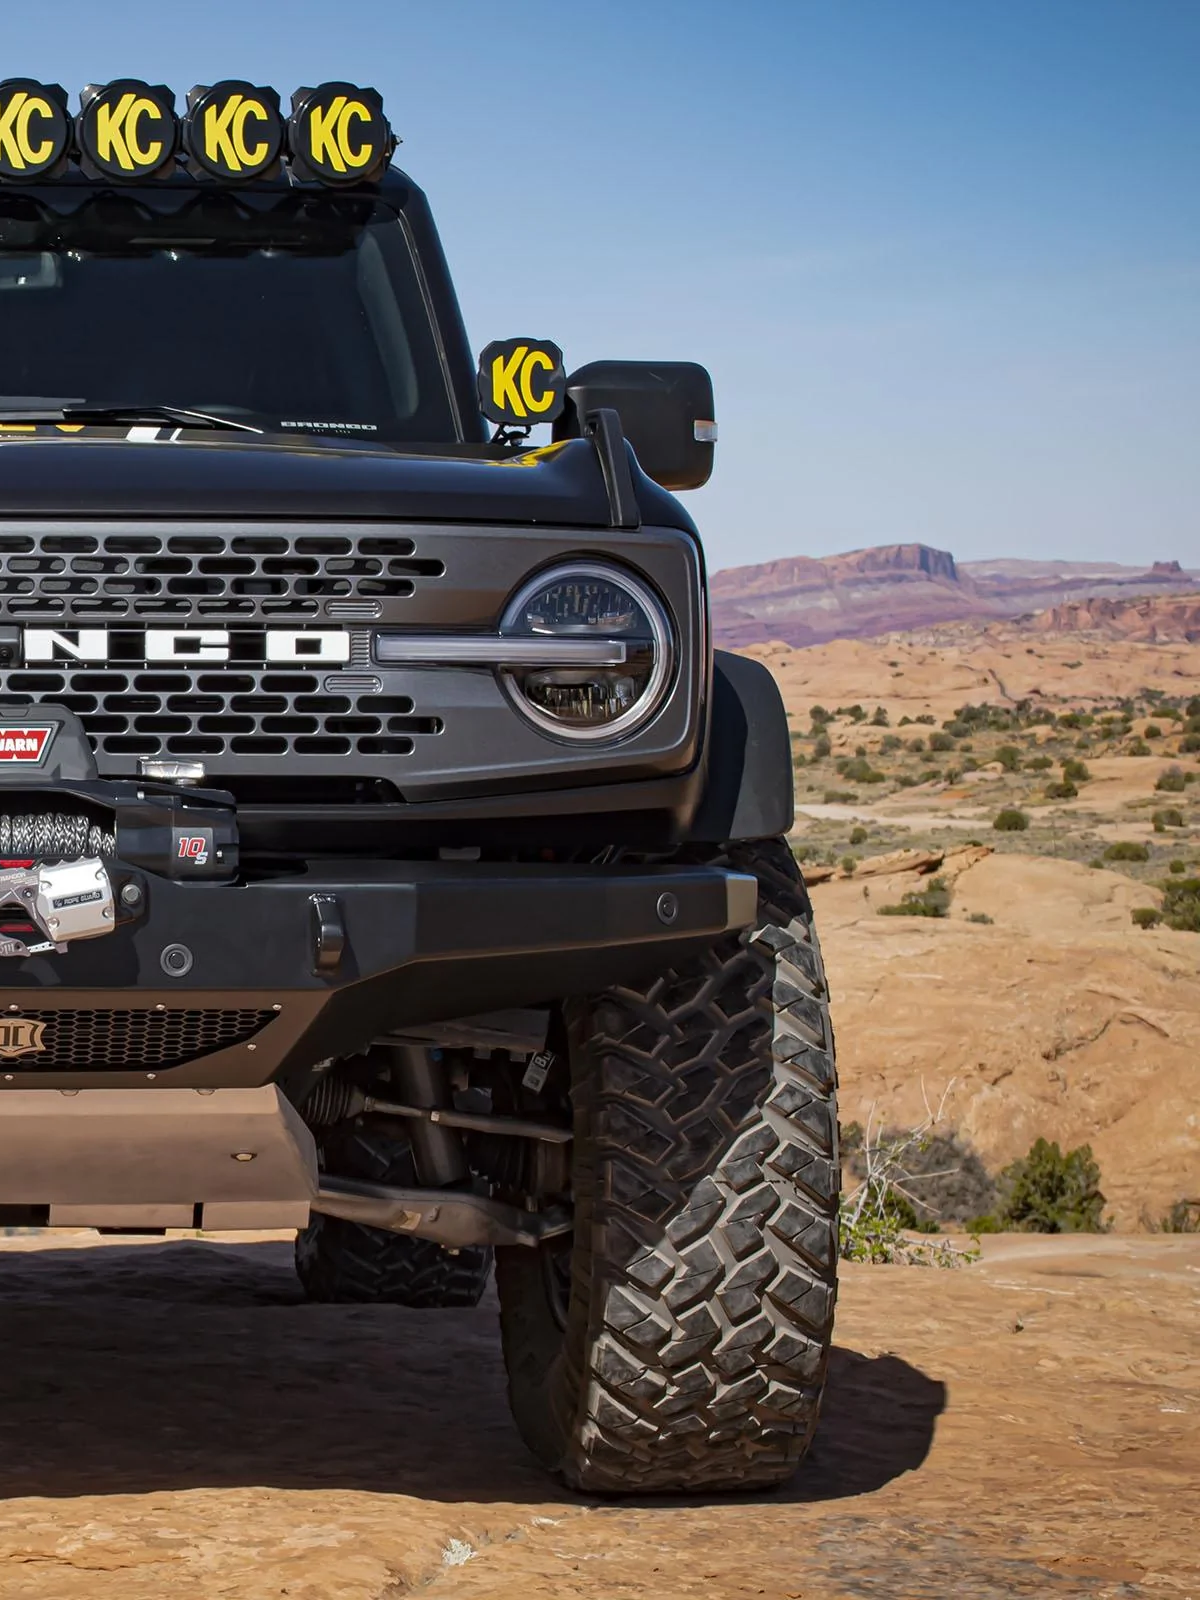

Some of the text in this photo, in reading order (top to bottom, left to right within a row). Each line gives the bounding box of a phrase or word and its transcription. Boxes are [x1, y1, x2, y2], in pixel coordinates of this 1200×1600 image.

[97, 93, 162, 171] KC
[204, 94, 269, 171] KC
[310, 96, 373, 173] KC
[492, 346, 555, 417] KC
[281, 421, 377, 430] BRONCO
